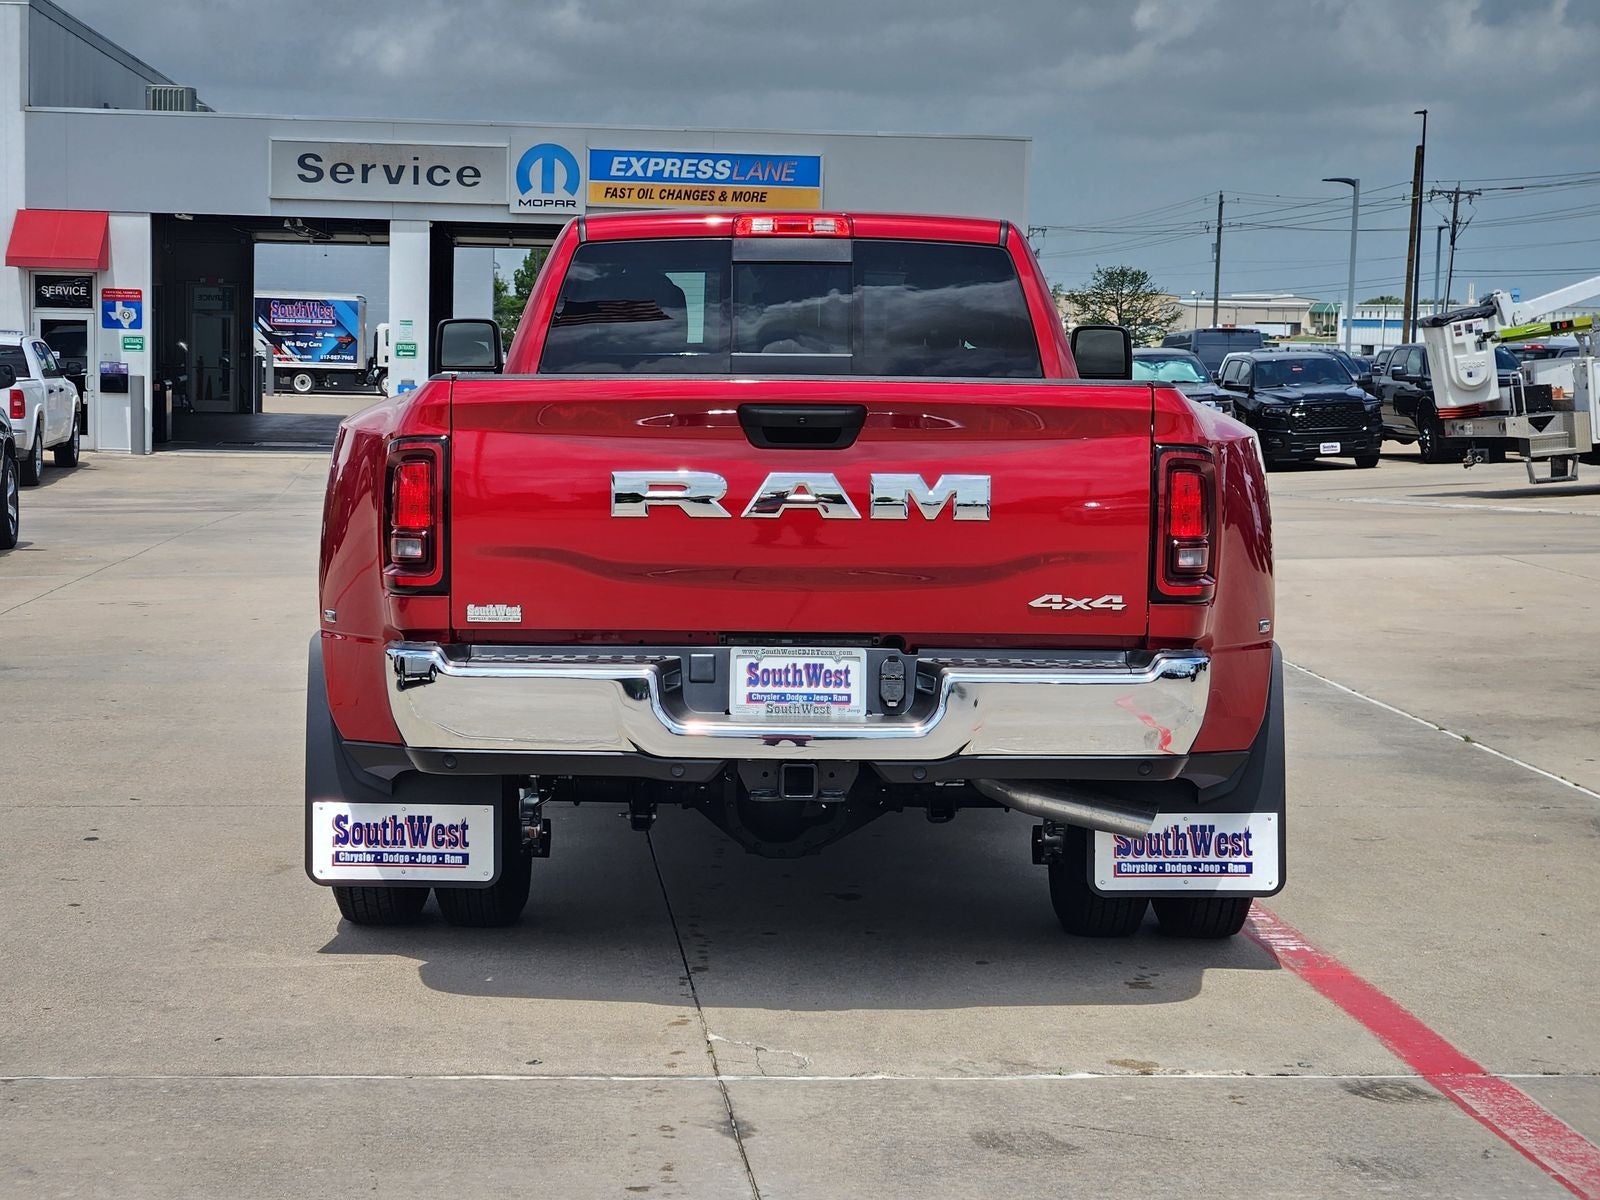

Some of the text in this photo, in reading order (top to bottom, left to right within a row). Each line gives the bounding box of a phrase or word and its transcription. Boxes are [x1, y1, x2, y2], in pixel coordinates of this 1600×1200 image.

[297, 153, 481, 187] Service
[604, 187, 767, 203] FAST OIL CHANGES & MORE
[518, 199, 576, 208] MOPAR
[41, 285, 87, 296] SERVICE
[271, 300, 336, 318] SouthWest
[610, 470, 992, 521] RAM
[467, 604, 522, 616] SouthWest
[746, 662, 851, 689] SouthWest
[751, 693, 780, 702] Chrysler
[785, 693, 808, 702] Dodge
[813, 694, 828, 703] Jeep
[766, 703, 832, 714] SouthWest
[332, 813, 470, 849] SouthWest
[338, 852, 463, 864] Chrysler Dodge Jeep Ram
[1121, 863, 1247, 874] Chrysler Dodge Jeep Ram
